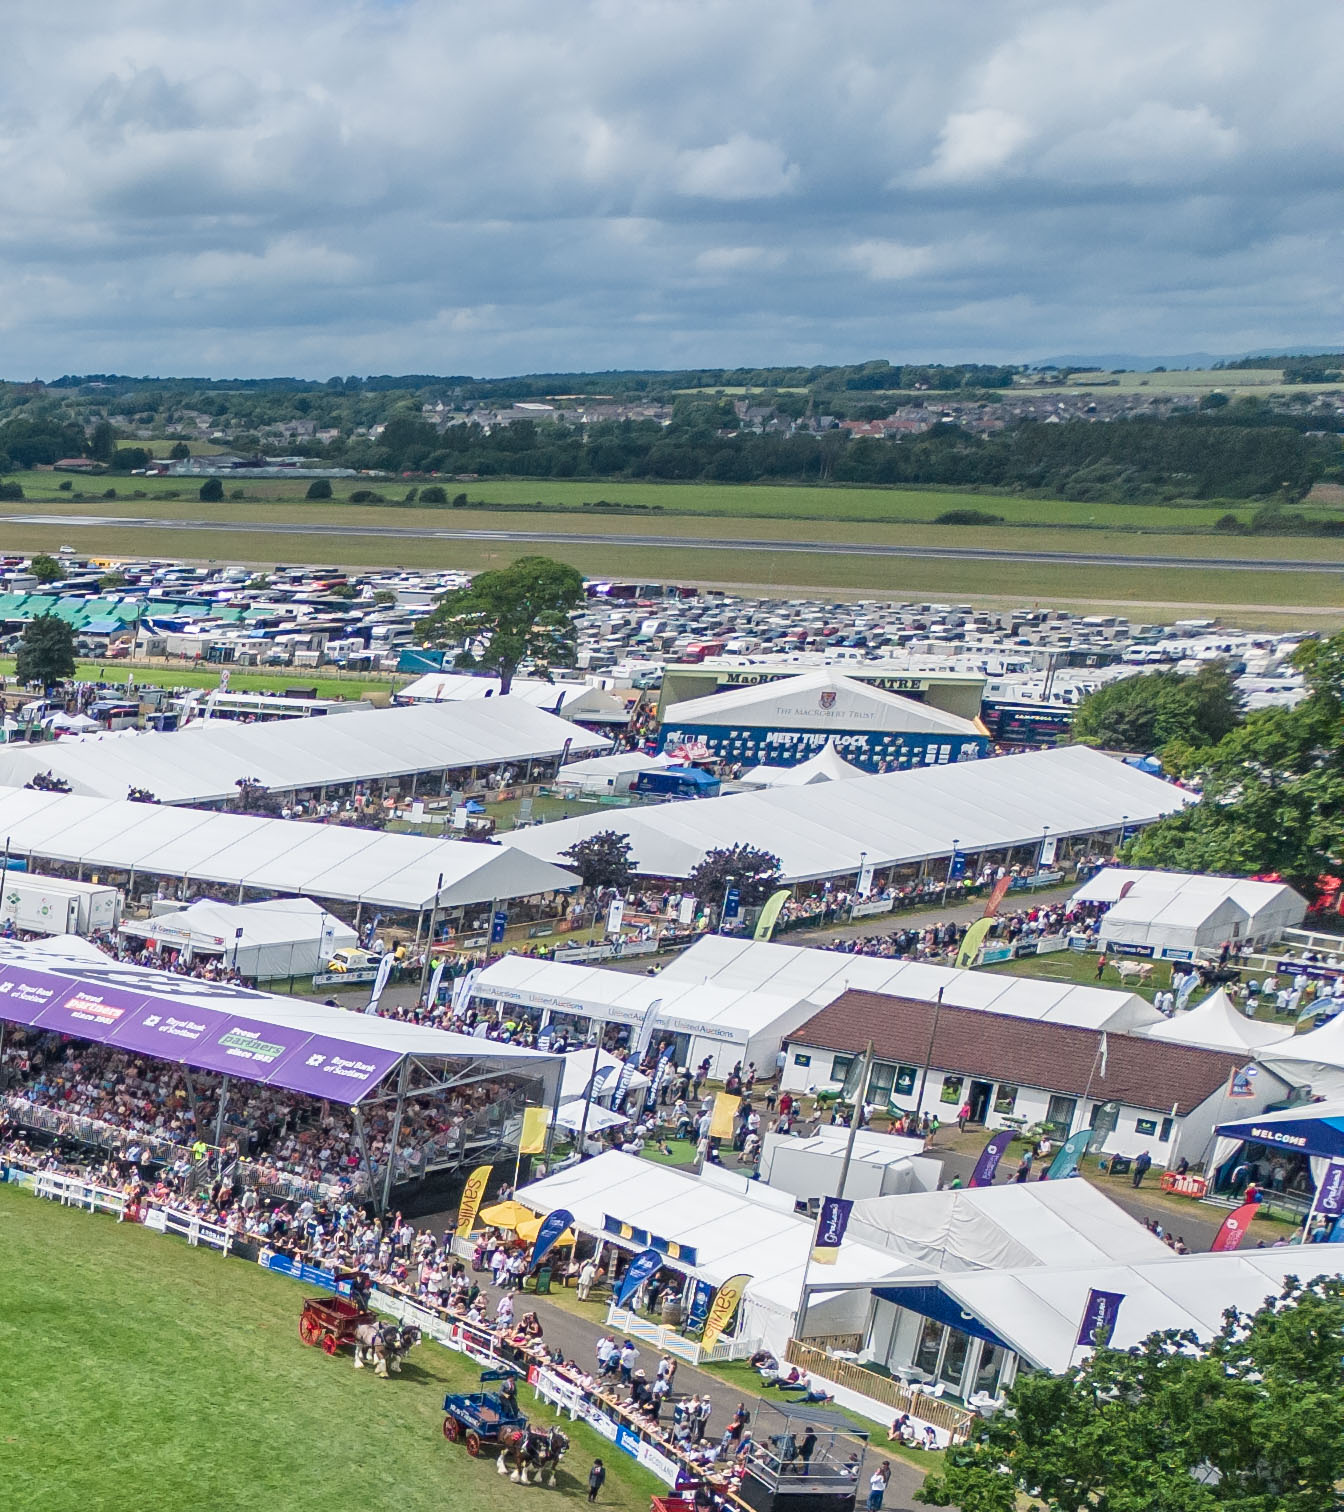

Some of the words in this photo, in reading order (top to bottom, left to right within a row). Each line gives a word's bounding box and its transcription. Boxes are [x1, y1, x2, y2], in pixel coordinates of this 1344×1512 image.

[766, 732, 800, 744] MEET
[801, 733, 828, 745] THE
[166, 1017, 186, 1029] Royal
[186, 1021, 207, 1032] Bank
[166, 1026, 200, 1039] Scotland
[230, 1027, 261, 1039] Proud
[221, 1034, 283, 1055] partners
[330, 1056, 353, 1069] Royal
[354, 1061, 376, 1073] Bank
[332, 1065, 369, 1080] Scotland
[612, 1062, 636, 1112] Galbraith
[1251, 1127, 1307, 1147] WELCOME
